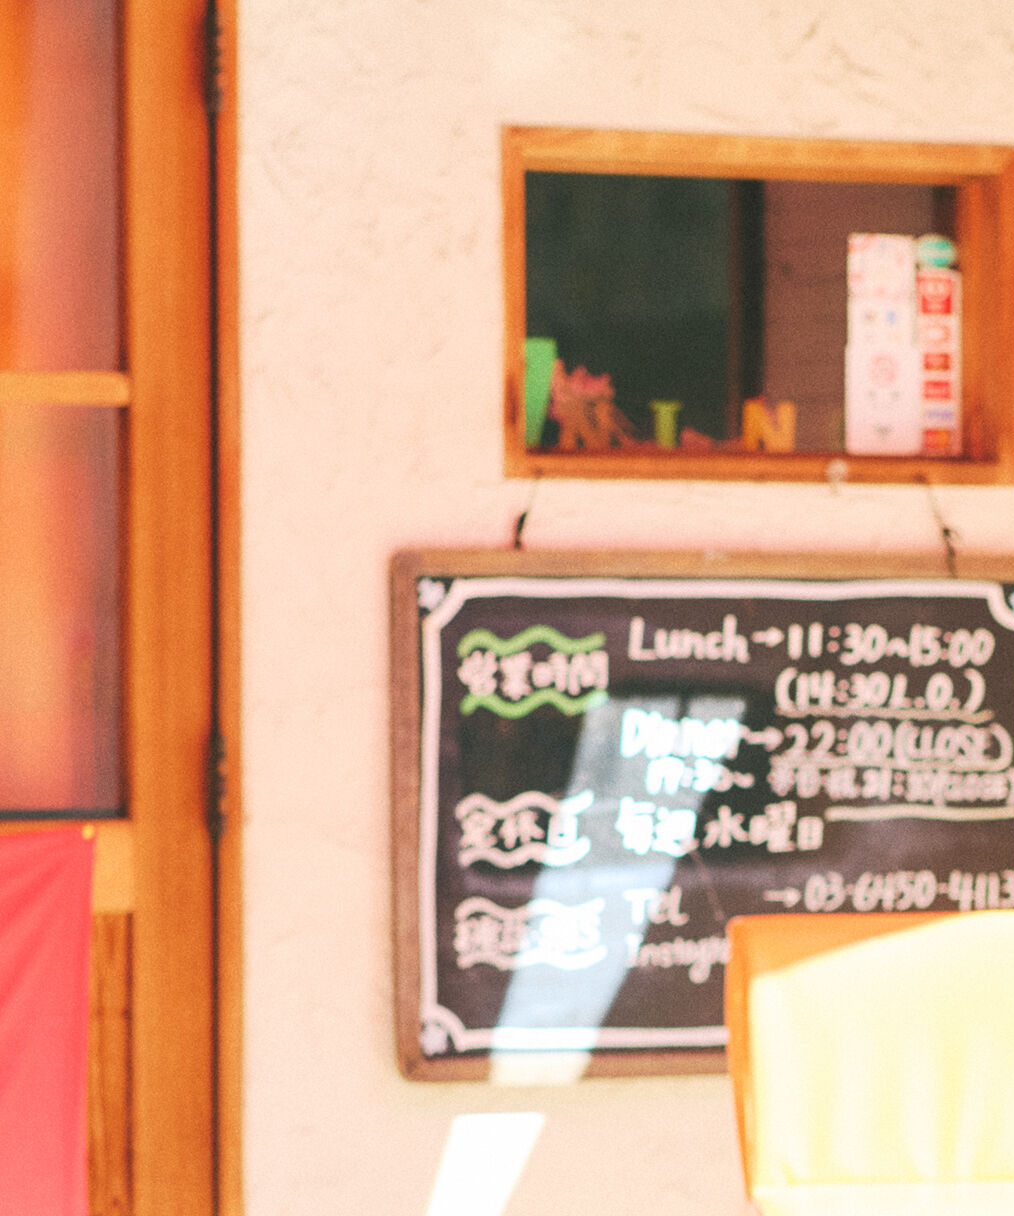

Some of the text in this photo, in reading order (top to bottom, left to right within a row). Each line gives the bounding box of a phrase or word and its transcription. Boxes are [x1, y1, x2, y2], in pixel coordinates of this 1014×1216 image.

[628, 613, 750, 664] Lunch
[459, 810, 579, 849] 定休日
[623, 885, 690, 927] Tel
